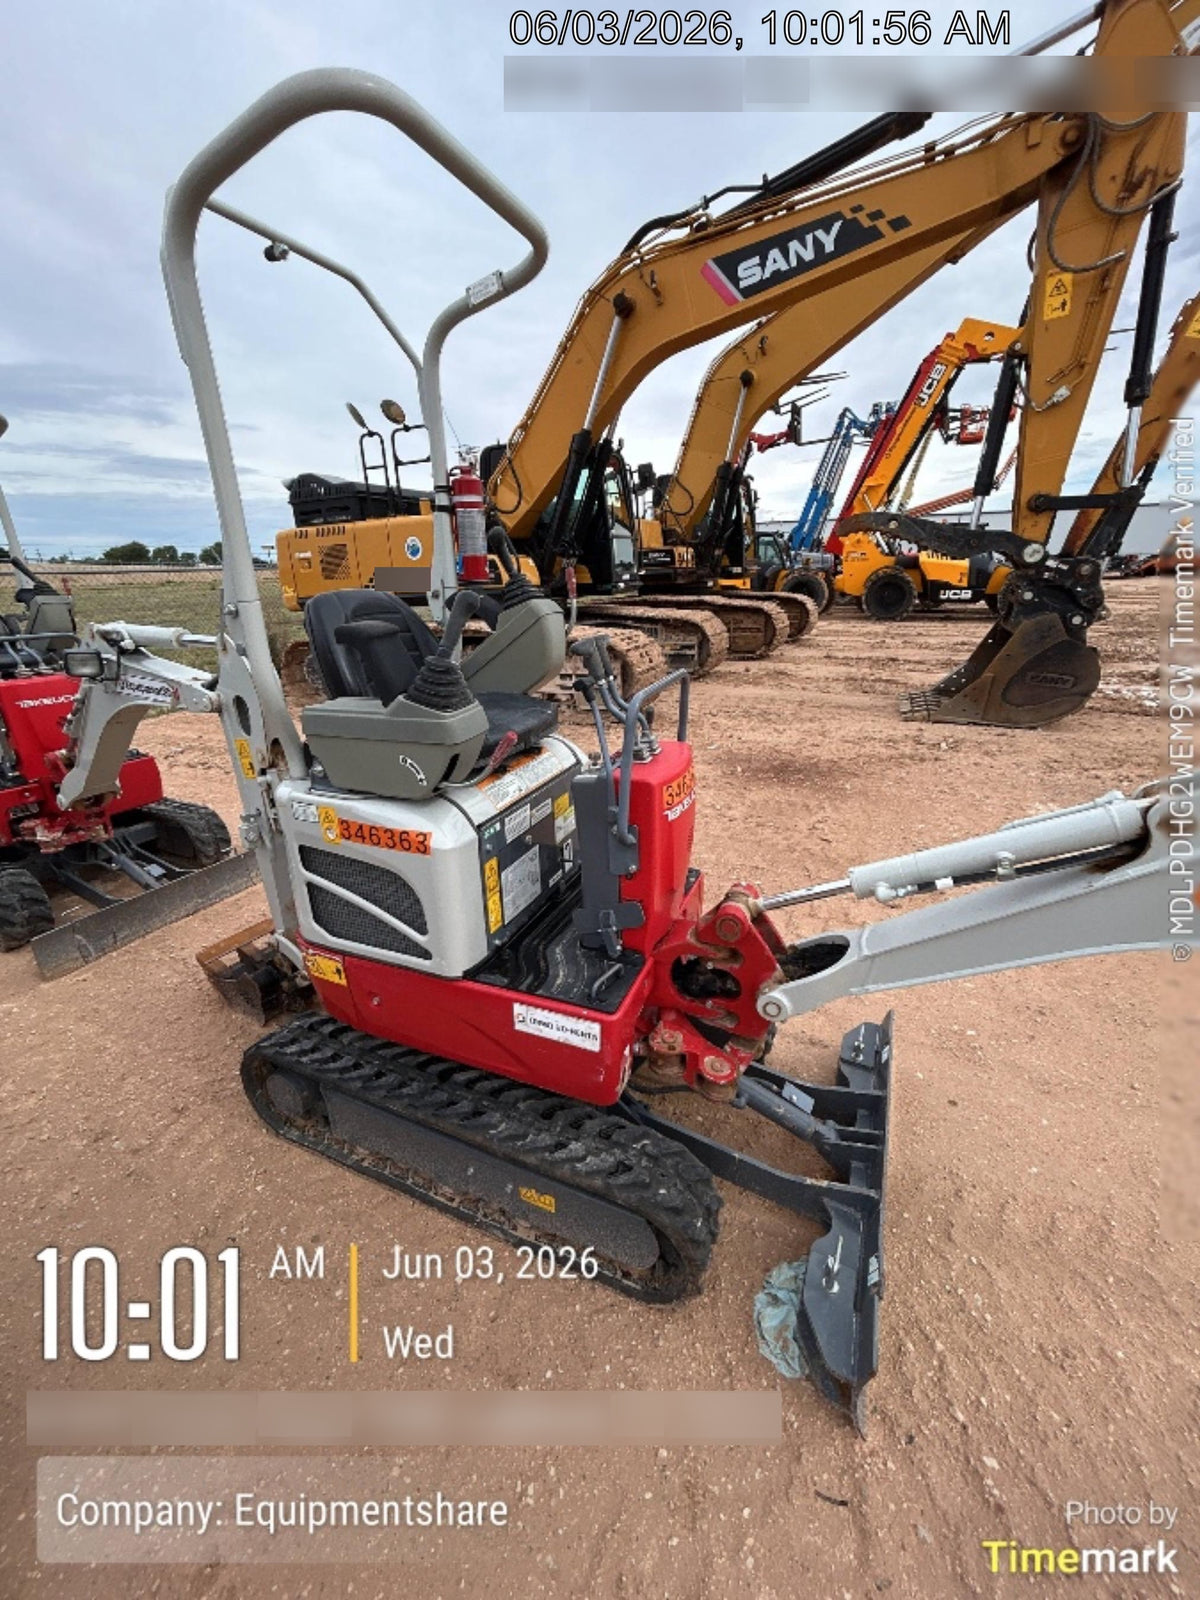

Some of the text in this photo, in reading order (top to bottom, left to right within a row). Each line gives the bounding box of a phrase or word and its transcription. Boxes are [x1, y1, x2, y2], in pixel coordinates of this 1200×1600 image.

[737, 220, 843, 289] SANY
[915, 363, 948, 408] JCB
[940, 589, 973, 600] JCB
[340, 819, 428, 854] 346363
